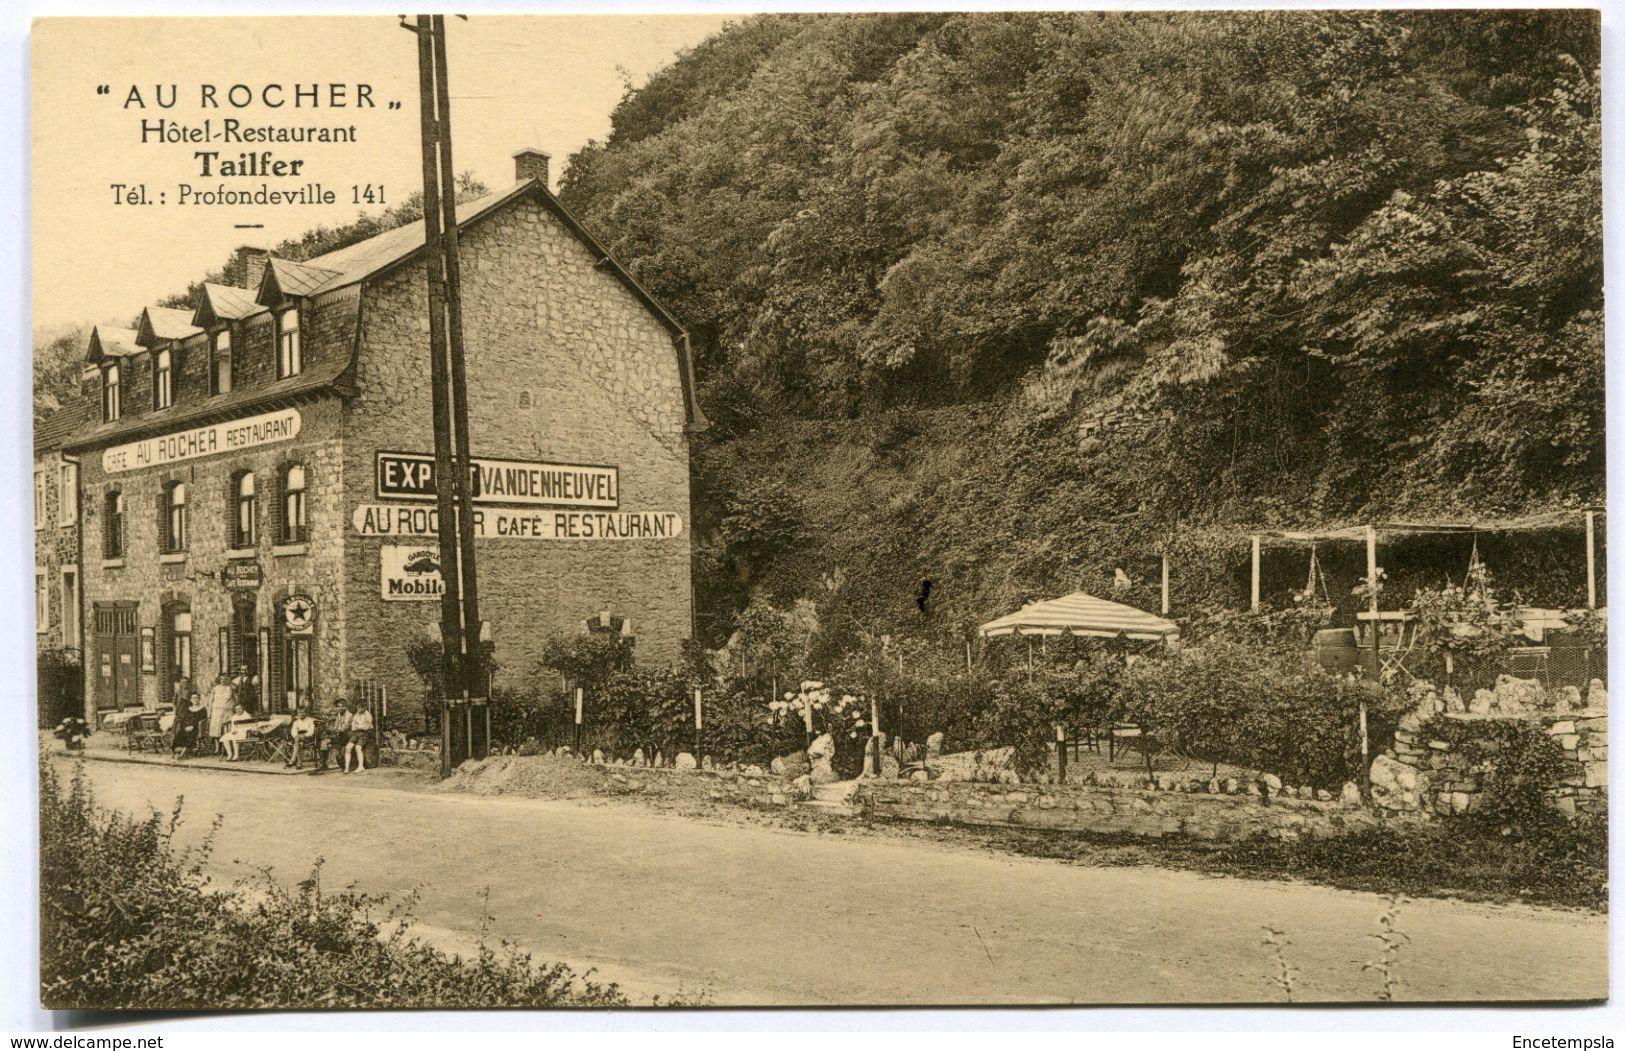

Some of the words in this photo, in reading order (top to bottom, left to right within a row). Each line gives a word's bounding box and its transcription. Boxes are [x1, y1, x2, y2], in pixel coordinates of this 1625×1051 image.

[136, 444, 151, 465] AU
[158, 429, 217, 460] ROCHER
[226, 416, 295, 448] RESTAURANT
[384, 461, 477, 492] EXPT
[481, 466, 617, 501] VANDENHEUVEL
[361, 507, 391, 534] AU
[398, 508, 485, 536] ROCR
[497, 515, 542, 536] CAFÉ
[555, 513, 676, 538] RESTAURANT
